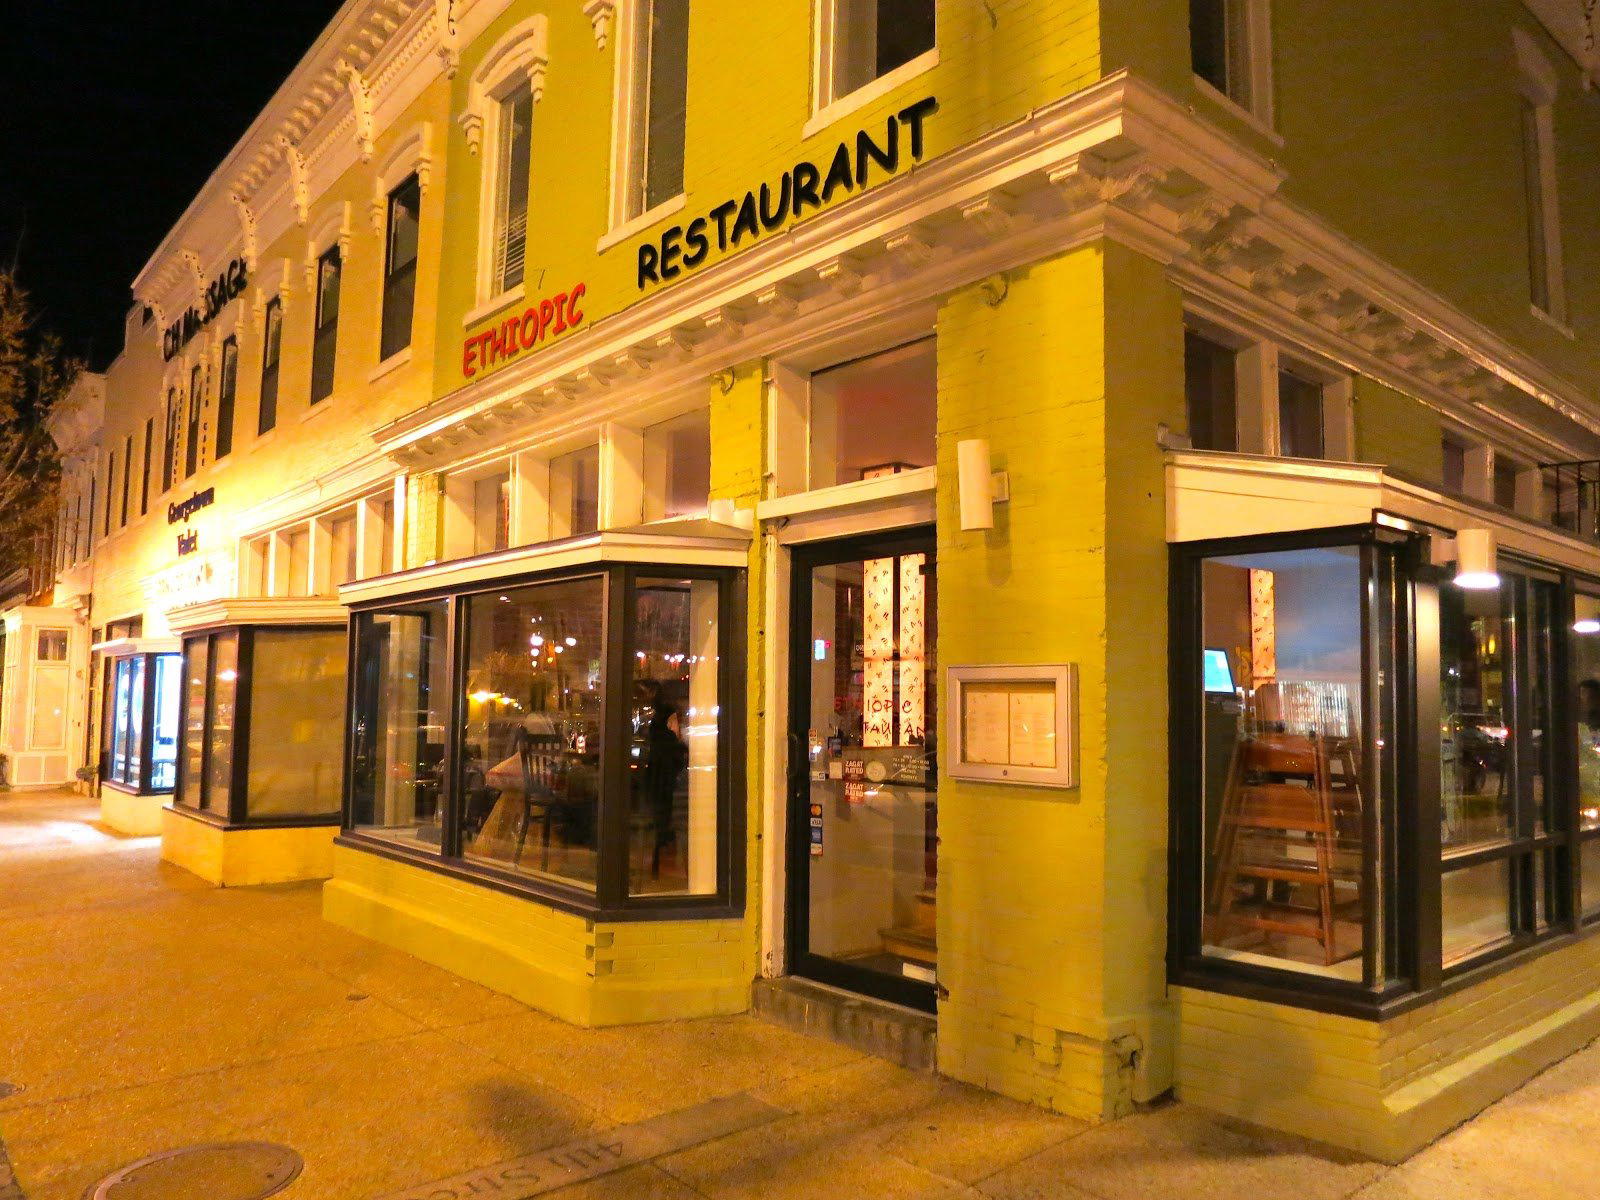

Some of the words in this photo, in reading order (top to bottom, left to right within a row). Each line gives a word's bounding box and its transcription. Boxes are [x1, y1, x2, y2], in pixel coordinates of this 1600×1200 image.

[637, 96, 938, 289] RESTAURANT
[463, 282, 586, 377] ETHIOPIC
[845, 760, 864, 768] ZAGAT
